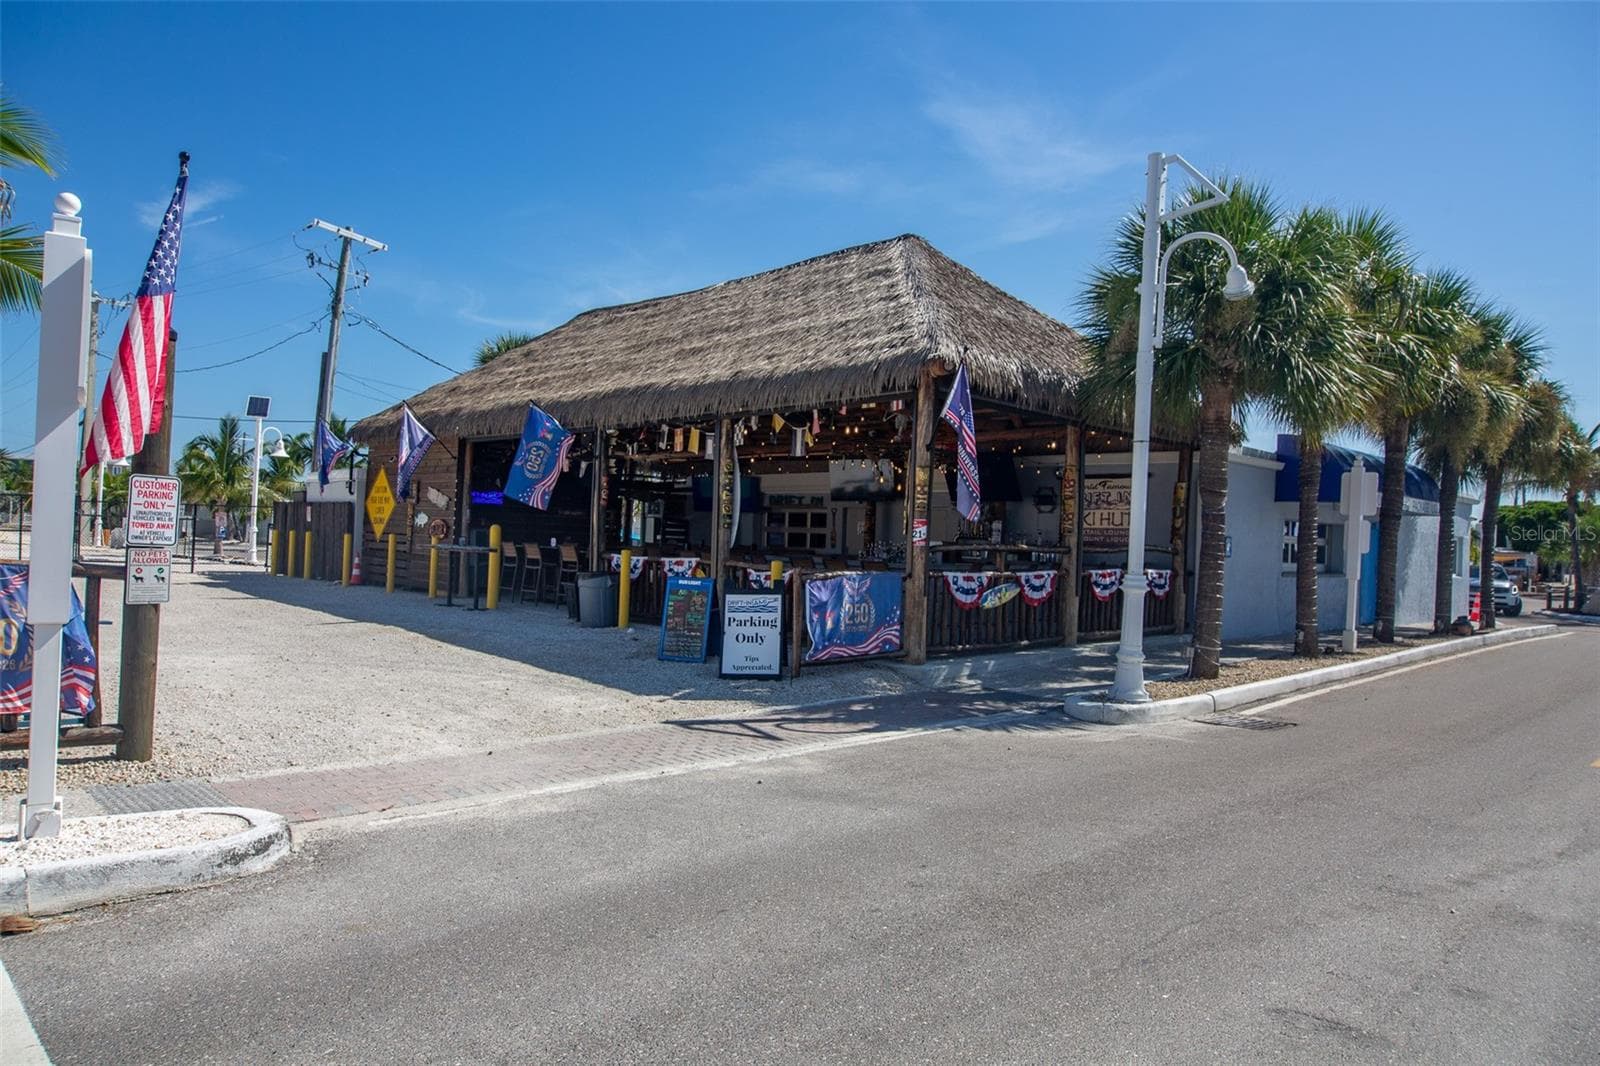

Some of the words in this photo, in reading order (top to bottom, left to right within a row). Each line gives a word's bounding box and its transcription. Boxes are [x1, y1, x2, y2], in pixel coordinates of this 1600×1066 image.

[133, 479, 178, 492] CUSTOMER
[137, 489, 174, 501] PARKING
[143, 500, 167, 510] ONLY
[1083, 511, 1096, 527] KI
[131, 521, 155, 529] TOWED
[155, 522, 175, 530] AWAY
[845, 602, 869, 624] 250
[727, 615, 779, 630] Parking
[735, 632, 767, 646] Only
[744, 655, 760, 663] Tips
[731, 663, 775, 672] Appreciated.
